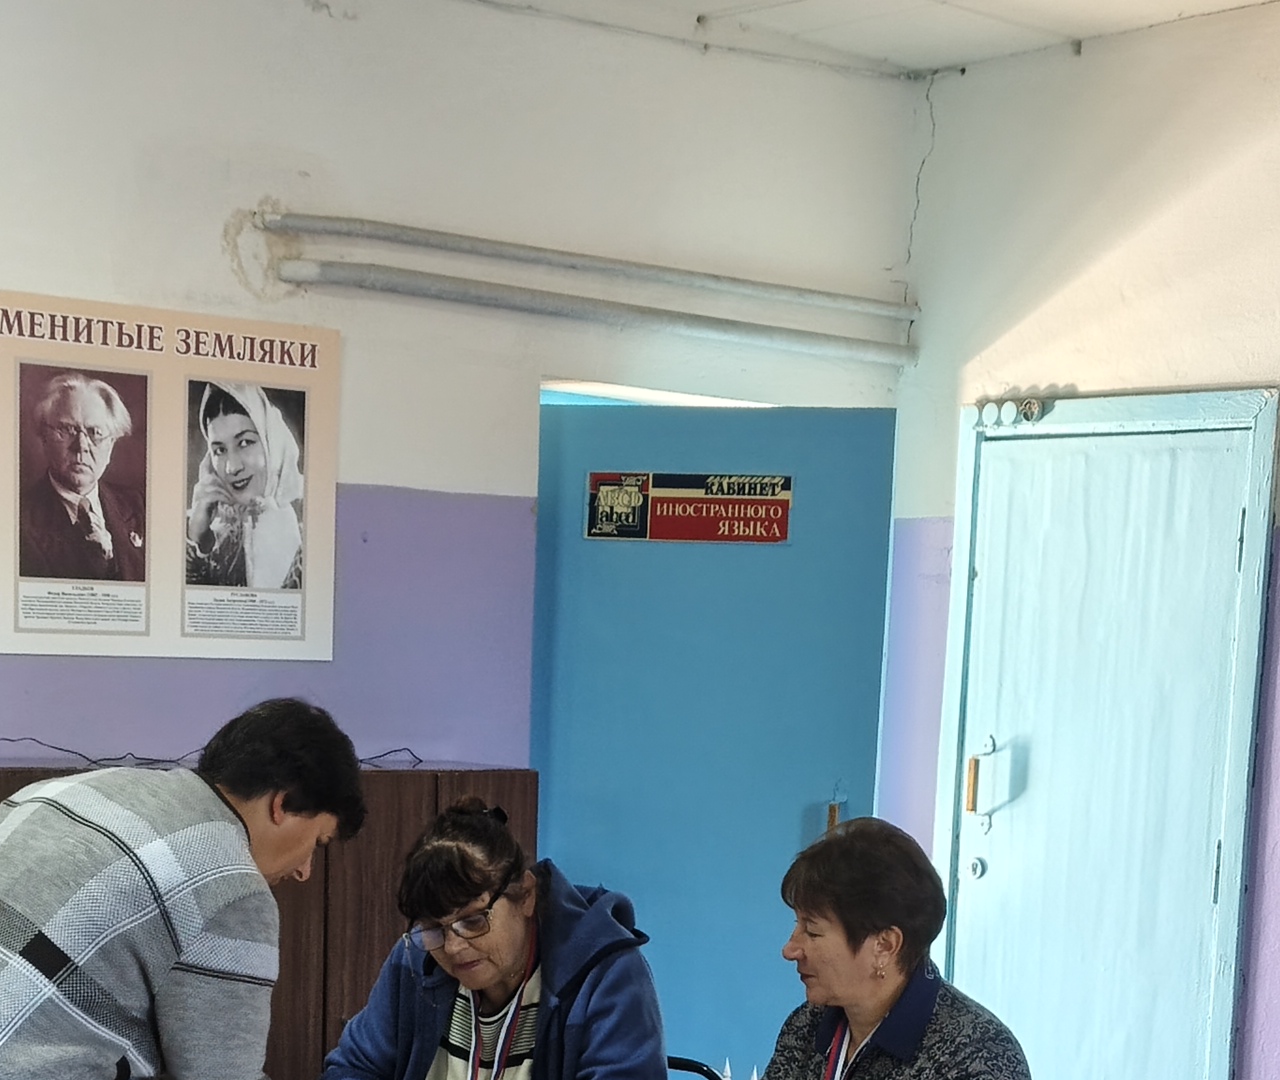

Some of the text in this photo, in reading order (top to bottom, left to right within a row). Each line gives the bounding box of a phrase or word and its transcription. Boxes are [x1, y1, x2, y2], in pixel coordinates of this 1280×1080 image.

[175, 327, 319, 369] ЗЕМЛЯКИ
[704, 480, 781, 497] КАБИНЕТ
[656, 503, 782, 519] ИНОСТРАННОГО
[717, 520, 781, 537] ЯЗЫКА
